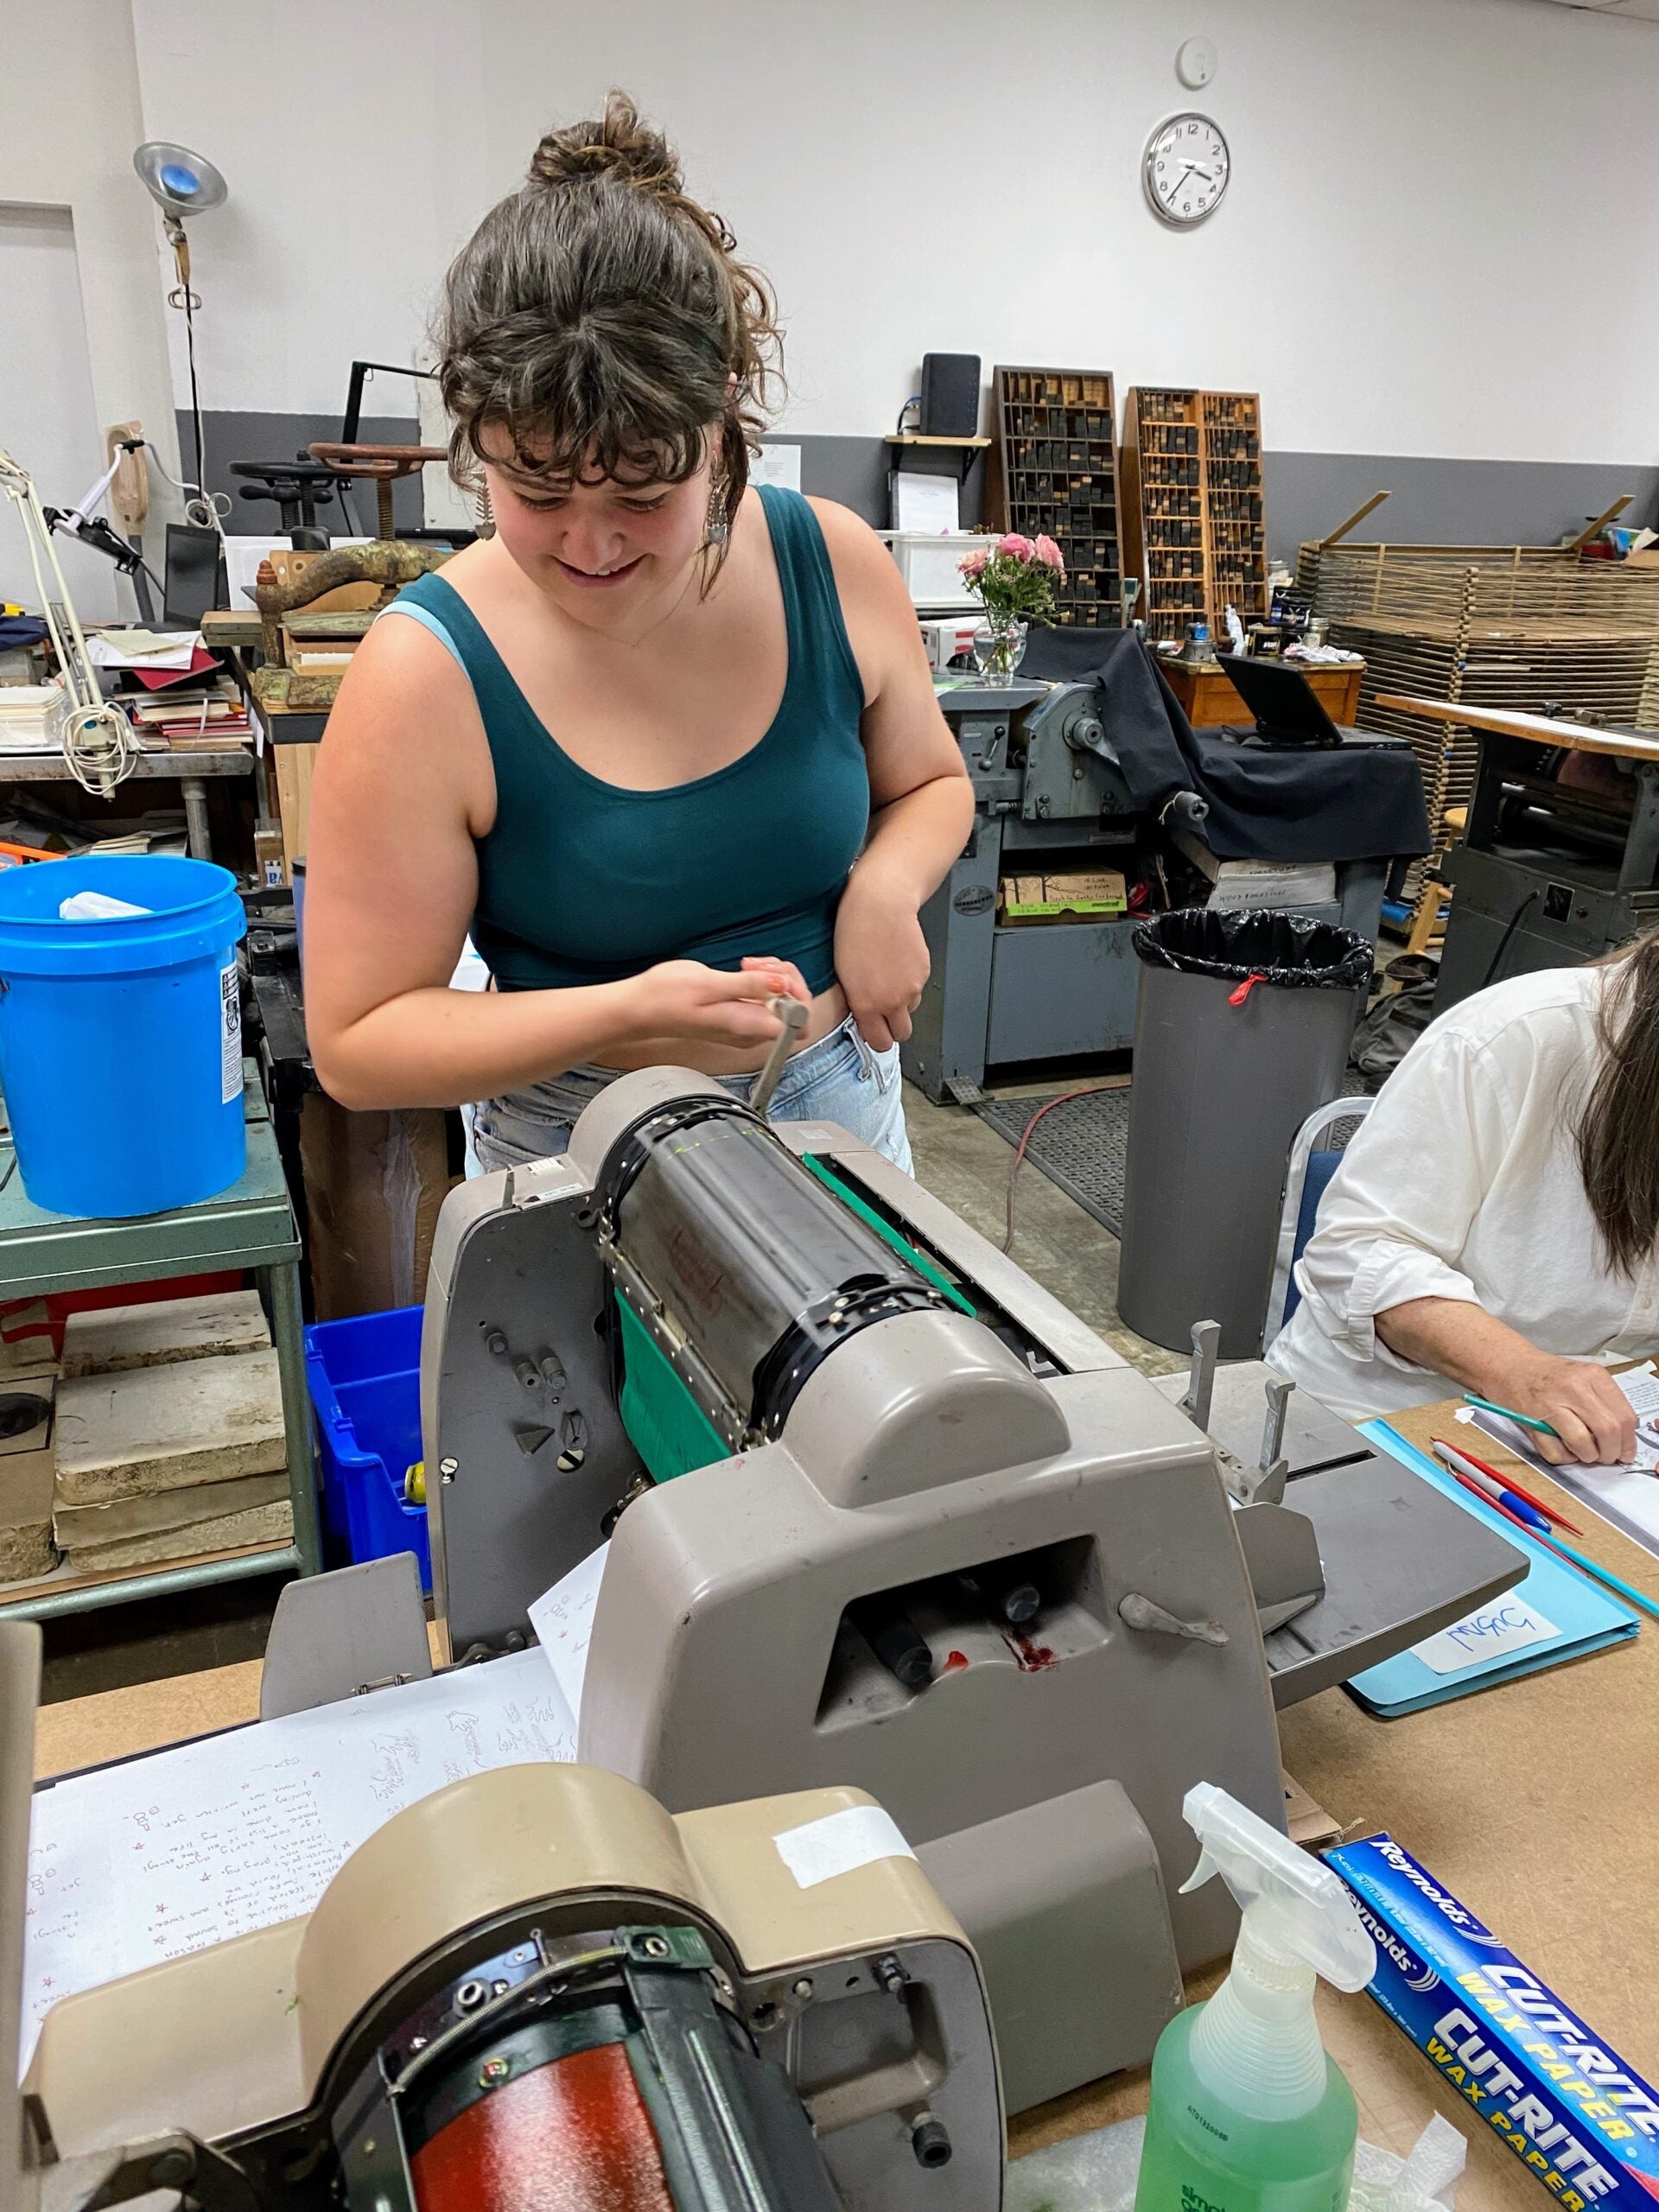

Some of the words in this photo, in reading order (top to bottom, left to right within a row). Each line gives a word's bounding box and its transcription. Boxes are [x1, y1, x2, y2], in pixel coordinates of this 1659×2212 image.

[1368, 1841, 1471, 1929] Reynolds
[1427, 2037, 1486, 2105] WAX
[1491, 2112, 1586, 2212] PAPER
[1433, 2008, 1619, 2202] CUT-RITE
[1456, 1971, 1532, 2032] WAX
[1522, 2043, 1636, 2140] PAPER
[1480, 1965, 1659, 2135] CUT-RITE
